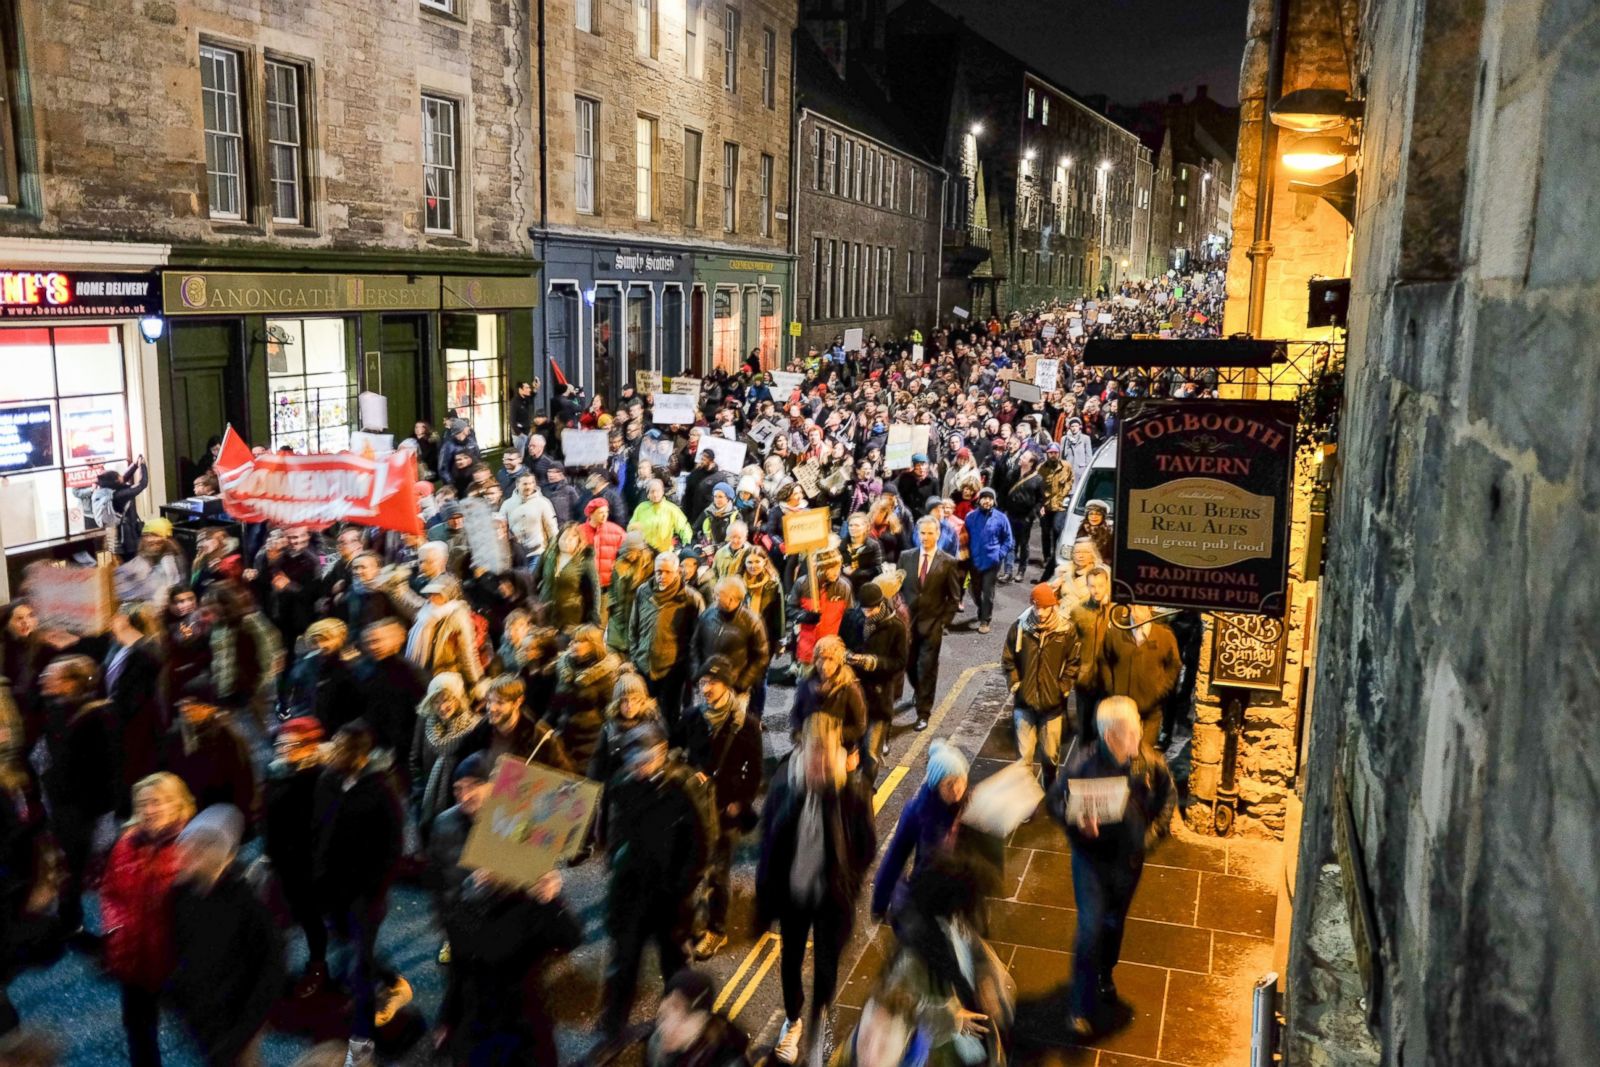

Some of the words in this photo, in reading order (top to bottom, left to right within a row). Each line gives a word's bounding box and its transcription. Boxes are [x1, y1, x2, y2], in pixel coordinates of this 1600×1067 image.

[614, 253, 644, 274] Simply
[645, 254, 675, 272] Scottish
[76, 281, 105, 296] HOME
[105, 281, 149, 296] DELIVERY
[181, 274, 337, 309] CANONGATE
[1127, 412, 1285, 449] TOLBOOTH
[1156, 454, 1251, 475] TAVERN
[1133, 536, 1159, 545] and
[1162, 538, 1198, 549] great
[1202, 540, 1229, 550] pub
[1233, 540, 1265, 552] food
[1137, 565, 1259, 586] TRADITIONAL
[1134, 583, 1220, 601] SCOTTISH
[1225, 589, 1259, 604] PUB
